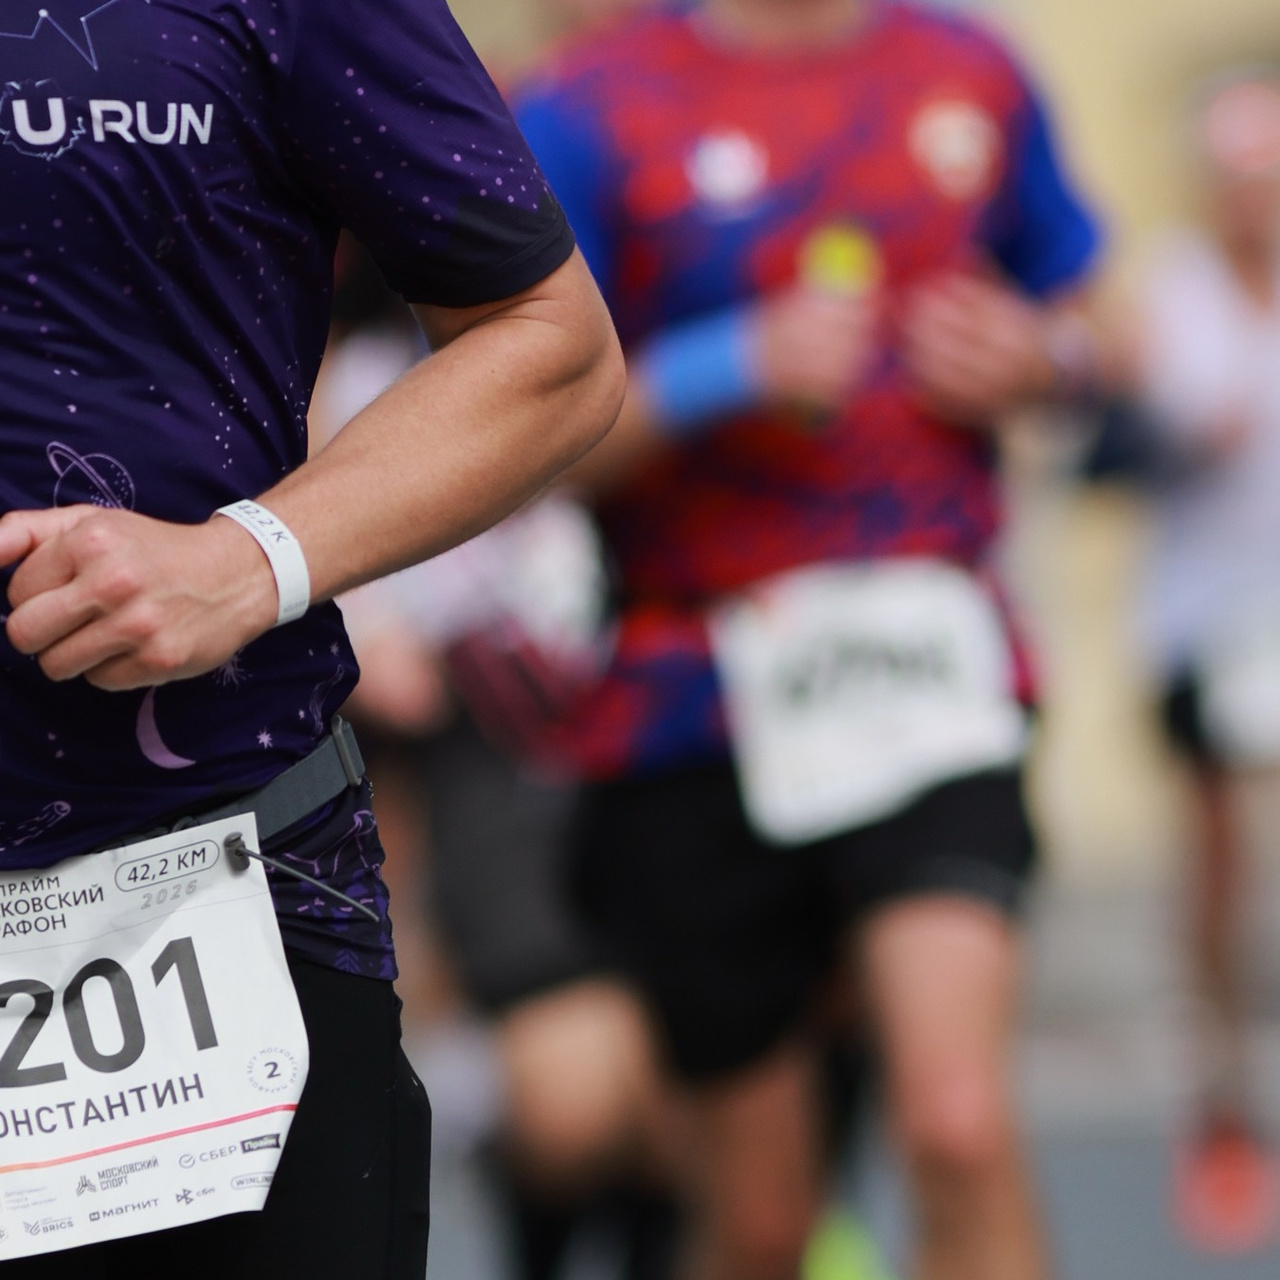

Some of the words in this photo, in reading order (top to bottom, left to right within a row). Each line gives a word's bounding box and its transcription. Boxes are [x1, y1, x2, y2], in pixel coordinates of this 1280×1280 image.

[11, 97, 67, 146] U
[88, 98, 214, 146] RUN
[127, 858, 169, 883] 42,2
[264, 1061, 282, 1079] 2
[198, 1145, 238, 1163] СБЕР
[97, 1157, 160, 1181] МОСКОВСКИЙ
[99, 1175, 129, 1191] СПОРТ
[42, 1220, 74, 1233] BRICS
